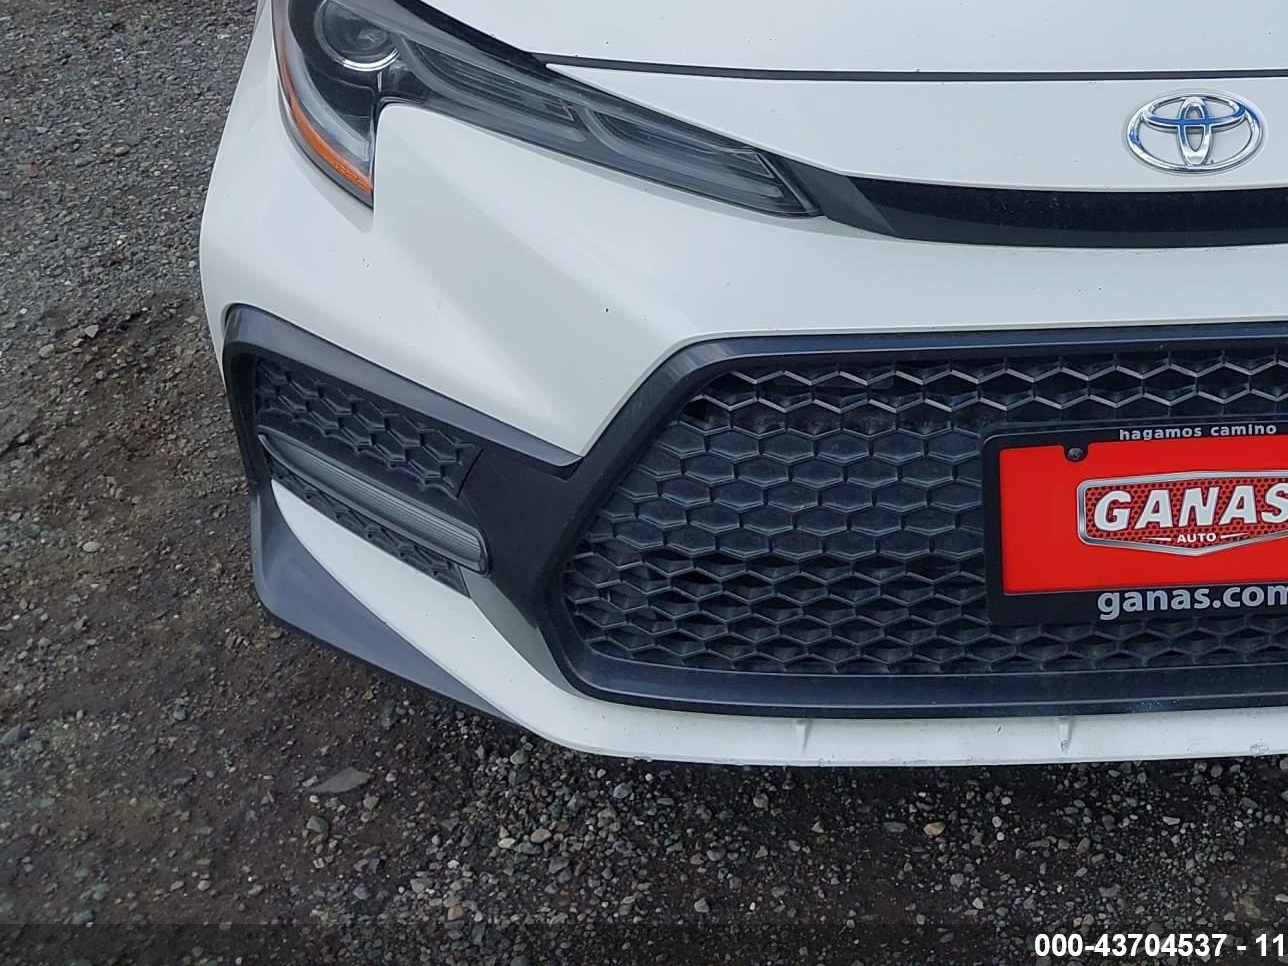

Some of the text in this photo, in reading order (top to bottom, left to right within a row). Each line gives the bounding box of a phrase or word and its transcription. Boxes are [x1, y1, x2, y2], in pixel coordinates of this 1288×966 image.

[1119, 424, 1277, 441] hagamos camino
[1177, 533, 1217, 543] AUTO
